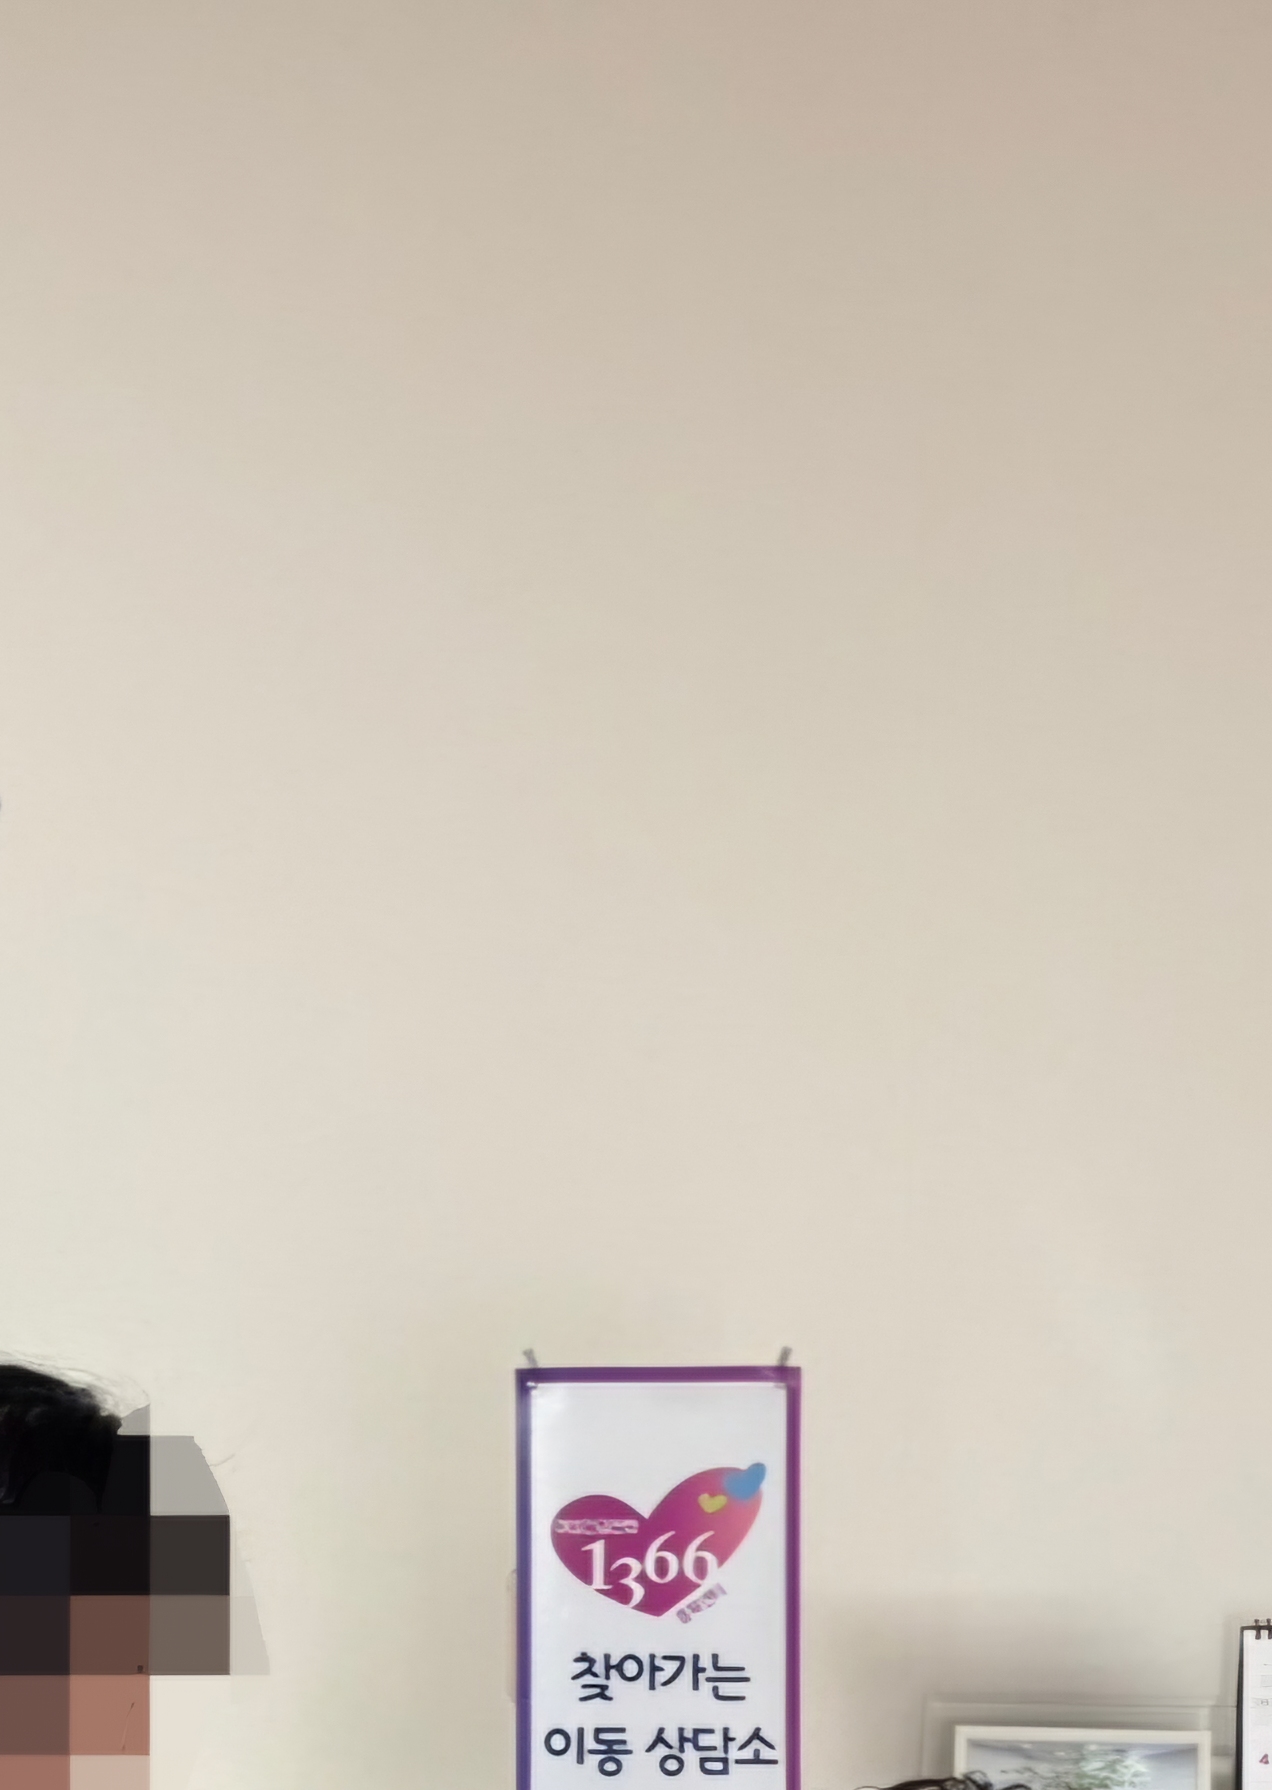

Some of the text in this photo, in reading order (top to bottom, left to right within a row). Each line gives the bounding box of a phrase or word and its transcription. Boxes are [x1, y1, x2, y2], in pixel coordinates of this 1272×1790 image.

[581, 1530, 719, 1609] 1366
[570, 1651, 751, 1702] 찾아가는
[544, 1726, 779, 1777] 이동 상담소
